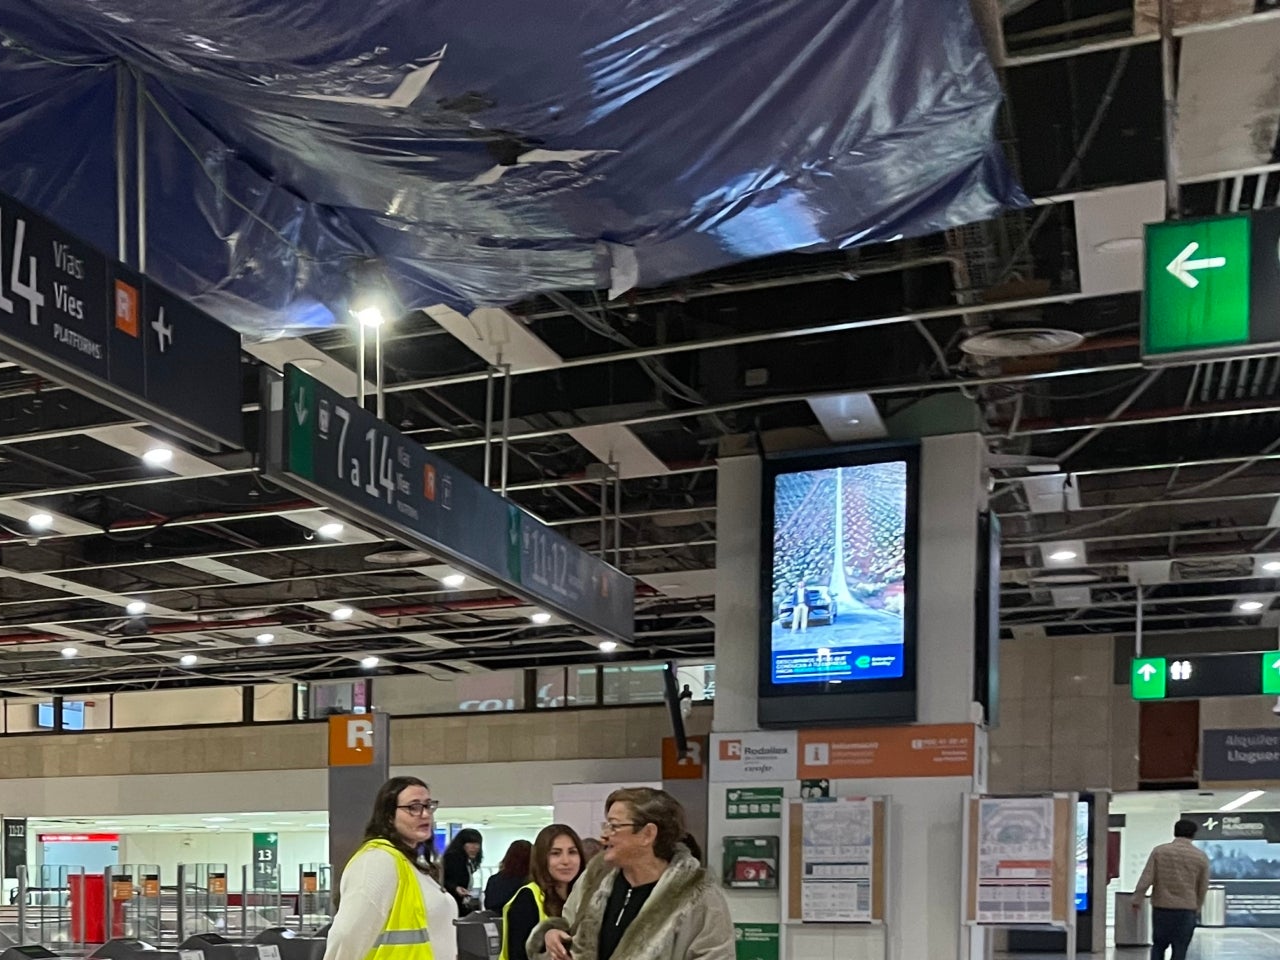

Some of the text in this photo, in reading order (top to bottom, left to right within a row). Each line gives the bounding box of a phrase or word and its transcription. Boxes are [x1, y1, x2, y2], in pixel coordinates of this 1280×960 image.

[53, 282, 84, 320] Vies
[53, 323, 102, 359] PLATFORMS
[335, 405, 396, 505] 7 a 14
[347, 719, 373, 748] R
[258, 849, 273, 861] 13
